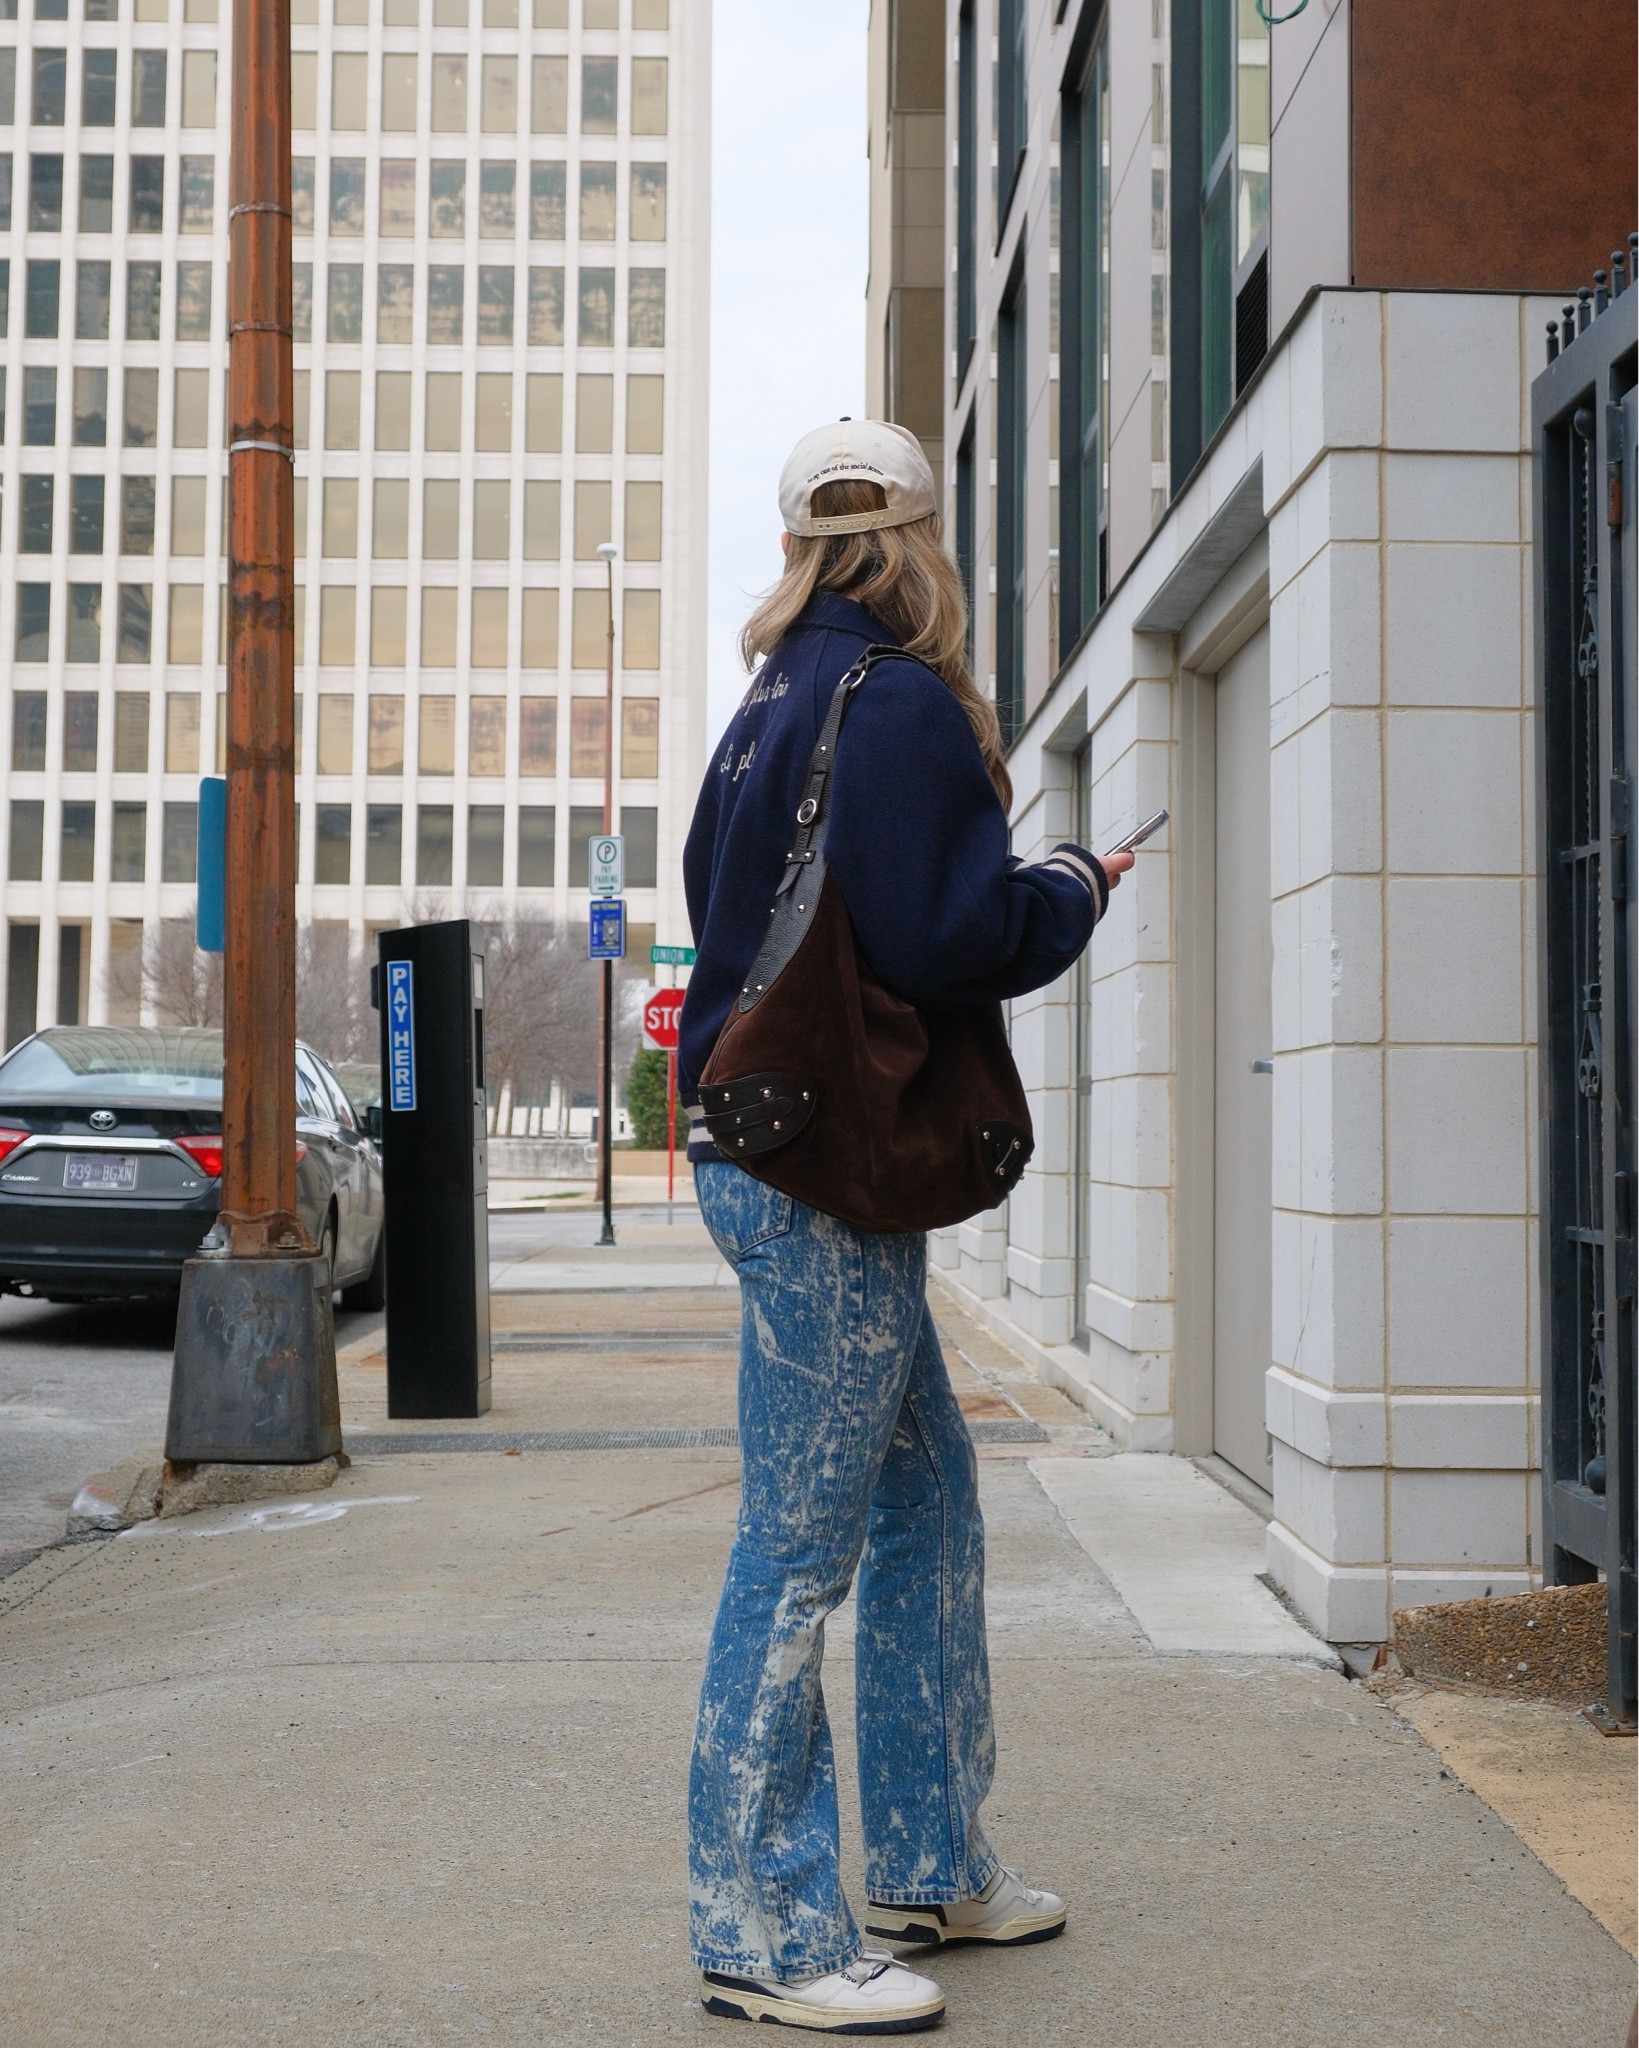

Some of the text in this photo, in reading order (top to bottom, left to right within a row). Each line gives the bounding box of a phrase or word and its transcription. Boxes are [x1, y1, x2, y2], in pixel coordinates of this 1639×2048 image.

[839, 463, 850, 471] the
[851, 462, 868, 470] social
[594, 875, 618, 884] PARKING
[653, 948, 685, 963] UNION
[647, 1006, 682, 1030] STO
[392, 967, 411, 1104] PAY HERE
[69, 1163, 133, 1182] 939 BGXN
